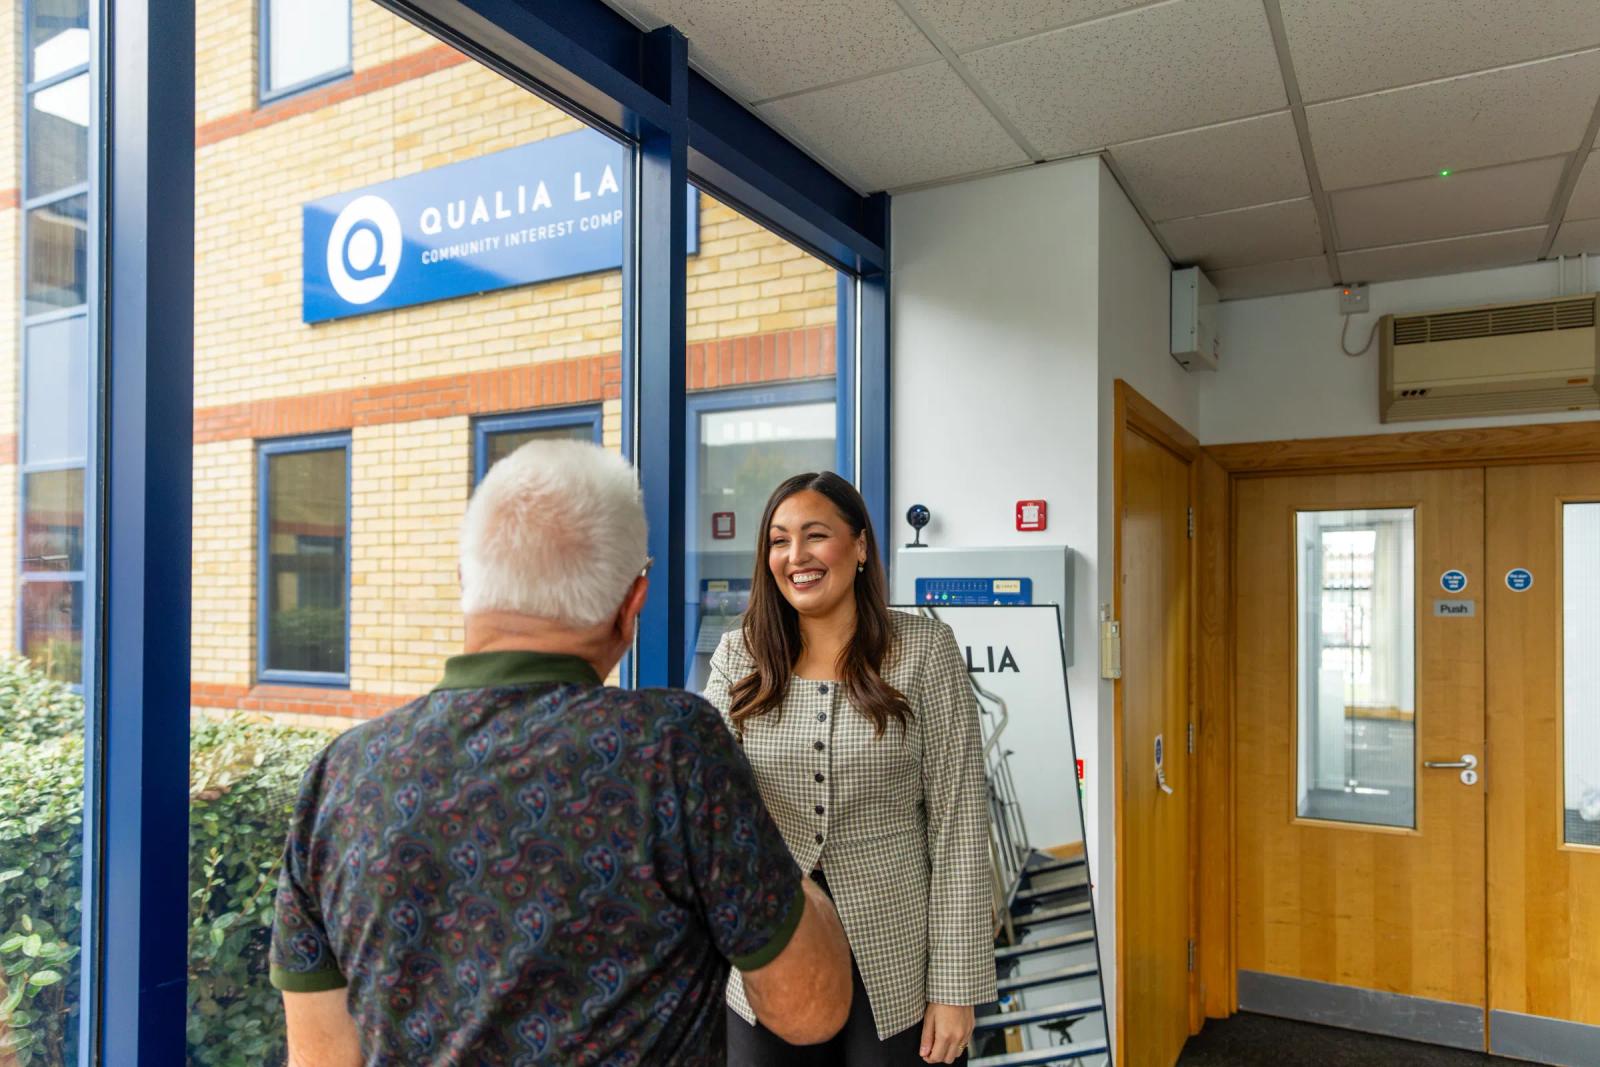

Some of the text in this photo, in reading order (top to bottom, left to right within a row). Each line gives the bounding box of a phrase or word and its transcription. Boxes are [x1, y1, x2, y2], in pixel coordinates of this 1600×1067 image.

[420, 164, 619, 235] QUALIA LA
[342, 218, 387, 281] Q
[421, 209, 623, 265] COMMUNITY INTEREST COMP
[1440, 603, 1468, 614] Push
[965, 645, 1021, 673] LIA
